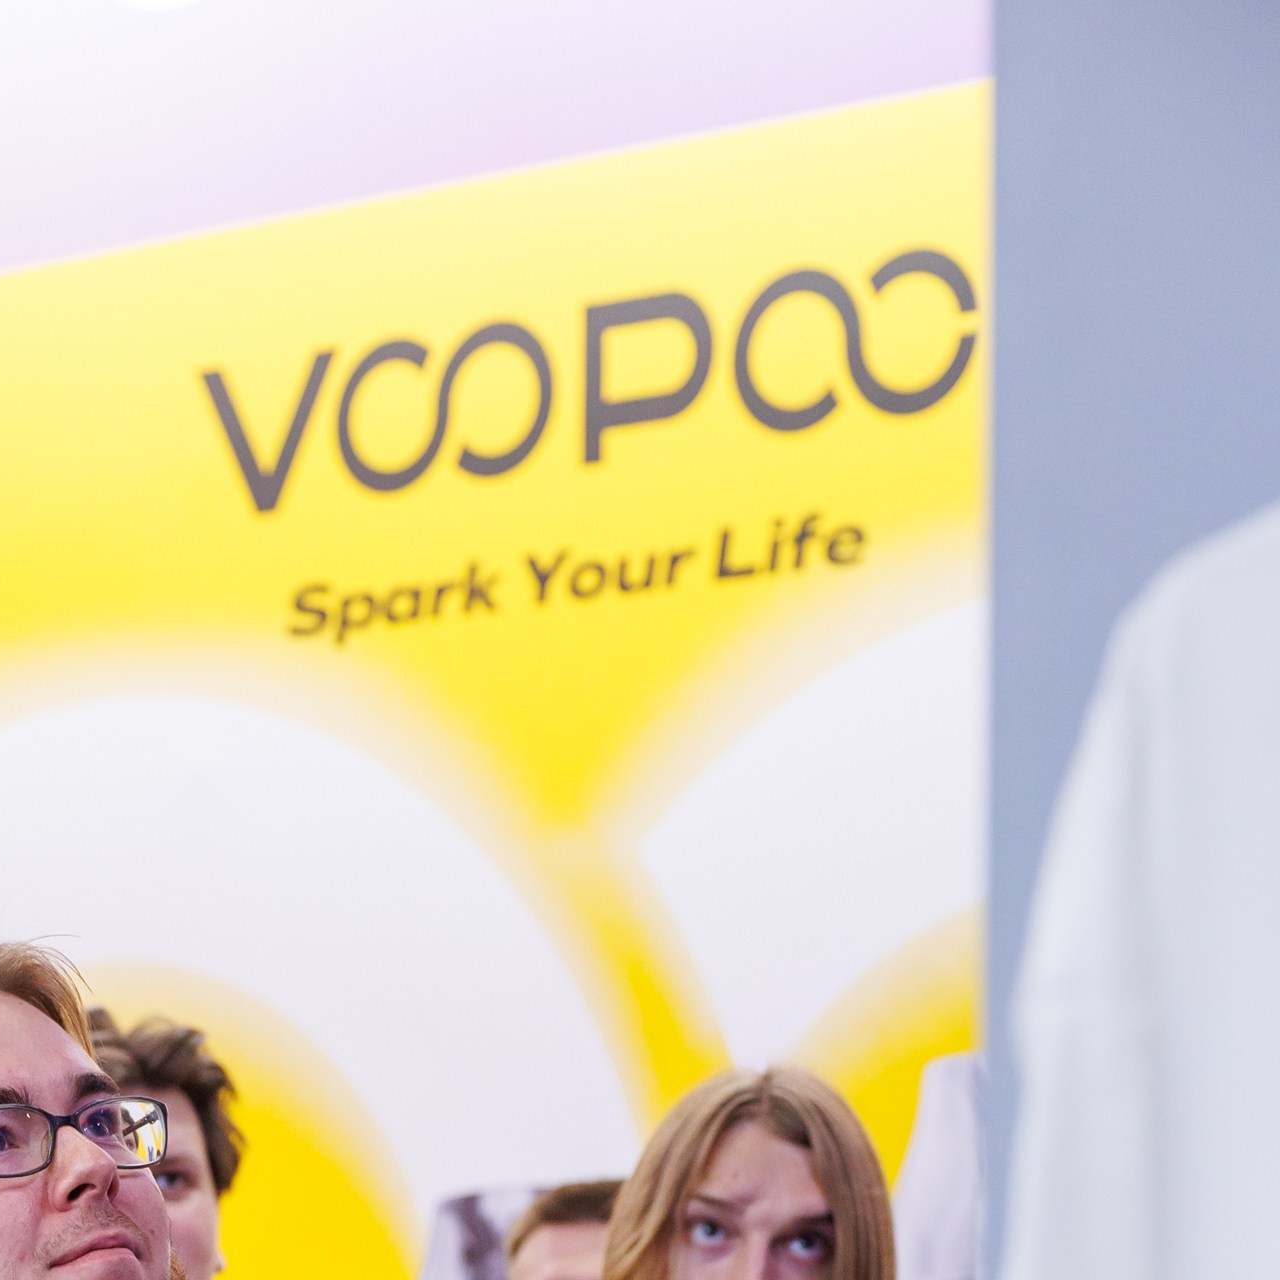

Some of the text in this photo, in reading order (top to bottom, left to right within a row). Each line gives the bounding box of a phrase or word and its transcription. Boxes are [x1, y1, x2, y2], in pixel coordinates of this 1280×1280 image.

[203, 248, 978, 516] VOOPOO
[290, 512, 868, 647] Spark Your Life
